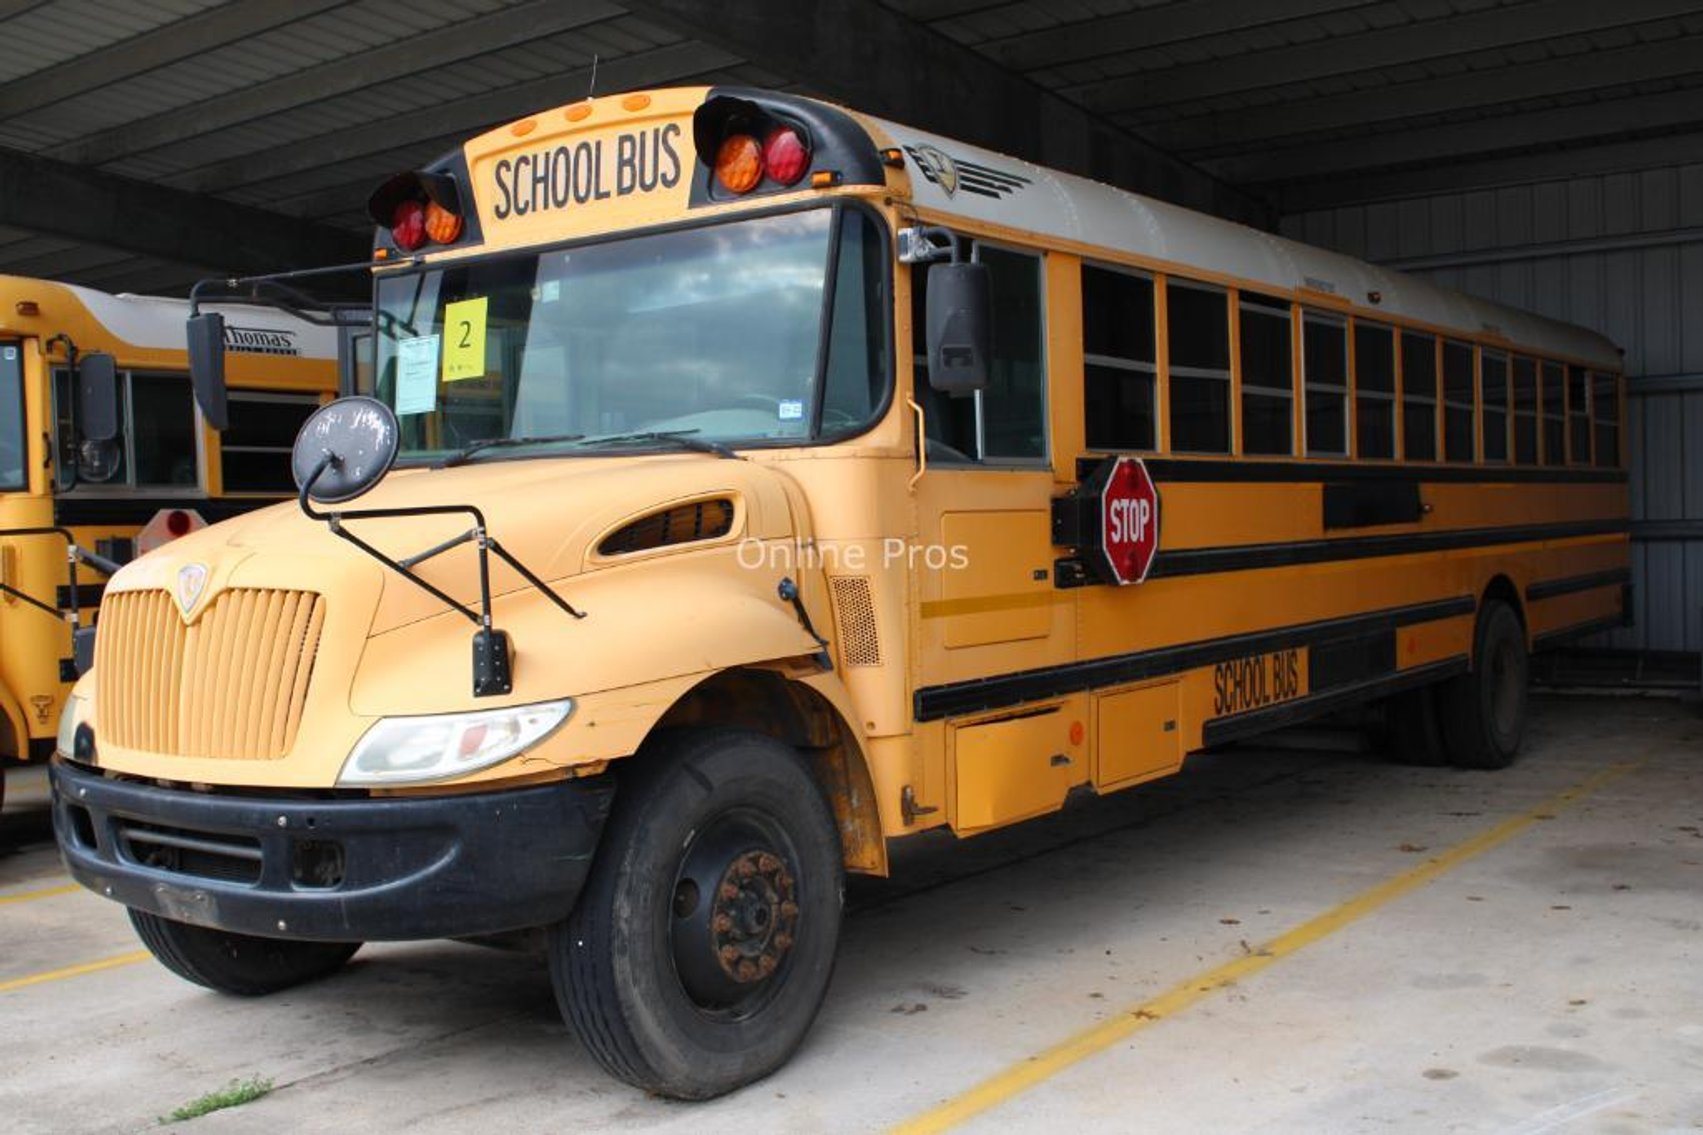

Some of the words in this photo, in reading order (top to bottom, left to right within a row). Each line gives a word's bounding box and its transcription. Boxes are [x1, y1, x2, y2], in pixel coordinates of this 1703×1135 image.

[494, 139, 611, 220] SCHOOL
[617, 122, 681, 196] BUS
[458, 320, 471, 349] 2
[1110, 498, 1150, 543] STOP
[1214, 653, 1270, 715] SCHOOL
[1273, 650, 1298, 701] BUS
